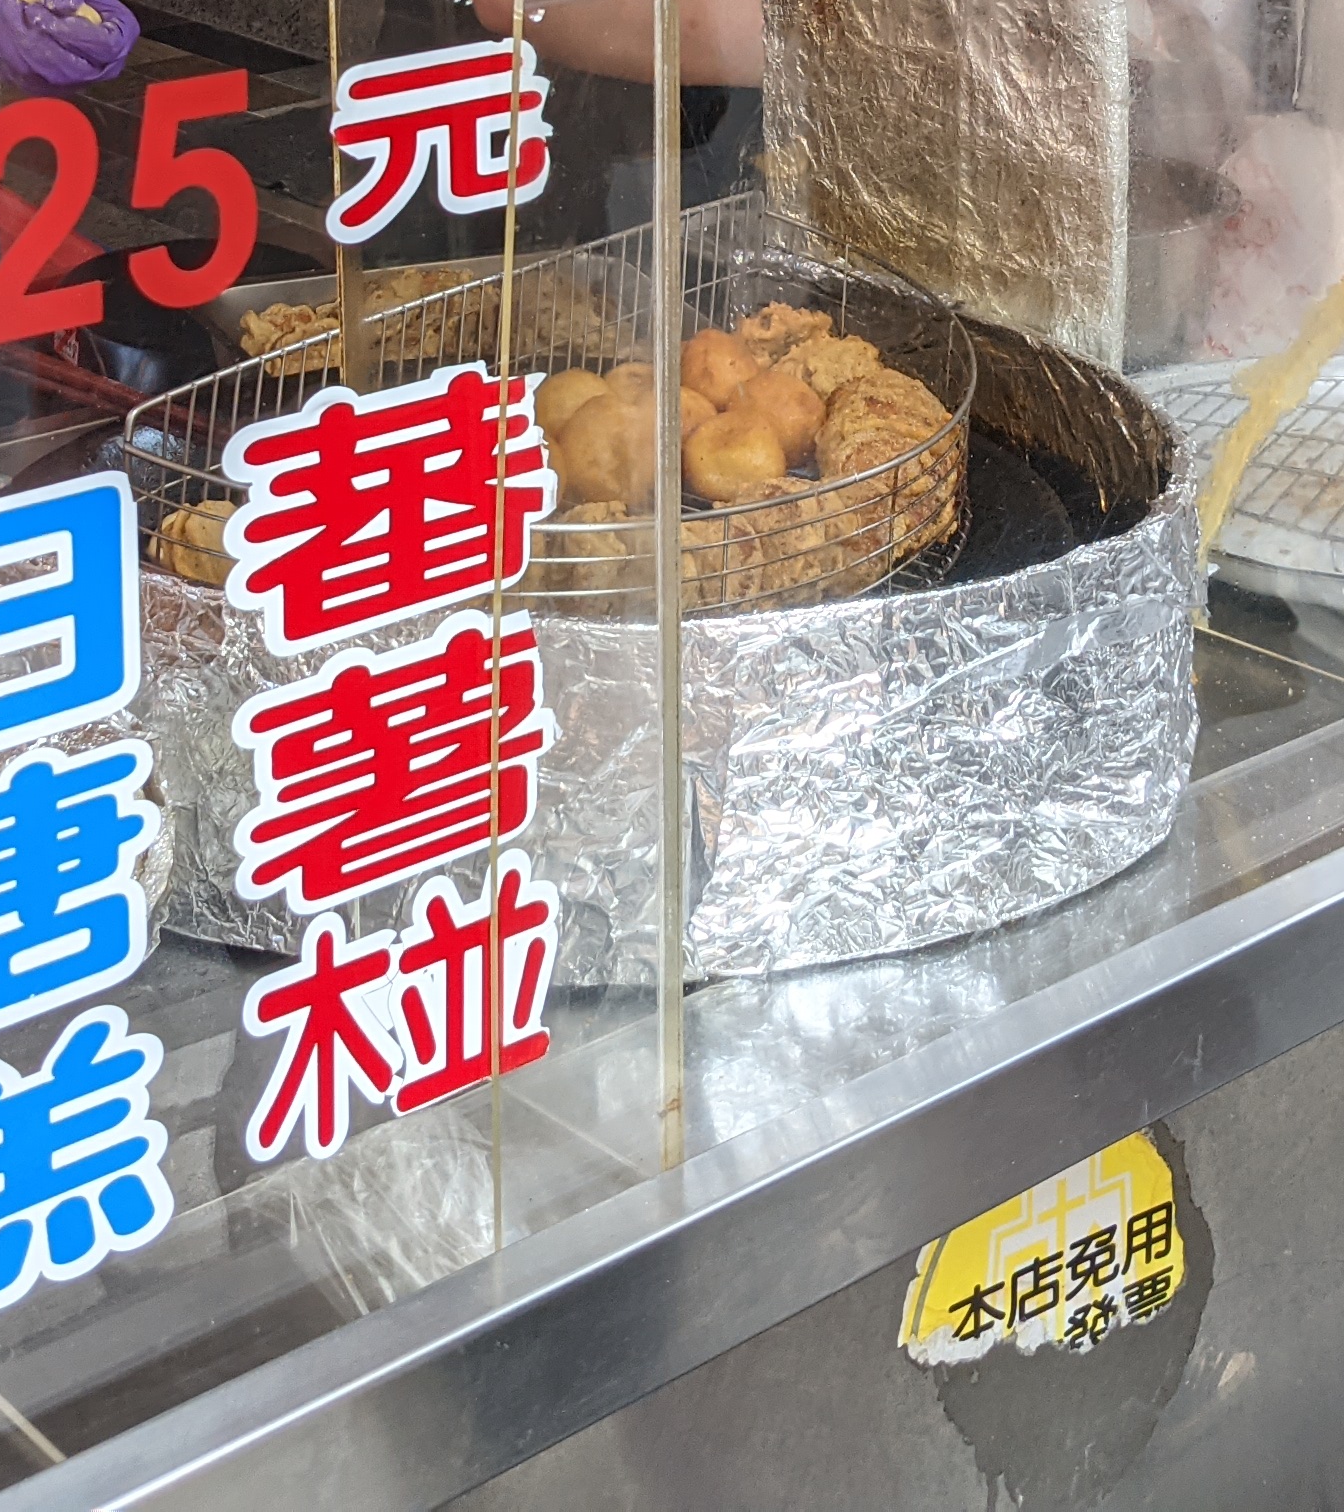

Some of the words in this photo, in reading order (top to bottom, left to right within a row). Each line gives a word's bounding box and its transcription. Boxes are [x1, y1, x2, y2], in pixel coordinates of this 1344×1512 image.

[226, 361, 557, 1161] 蕃薯椪
[948, 1200, 1173, 1343] 本店免用
[1064, 1264, 1174, 1351] 發票
